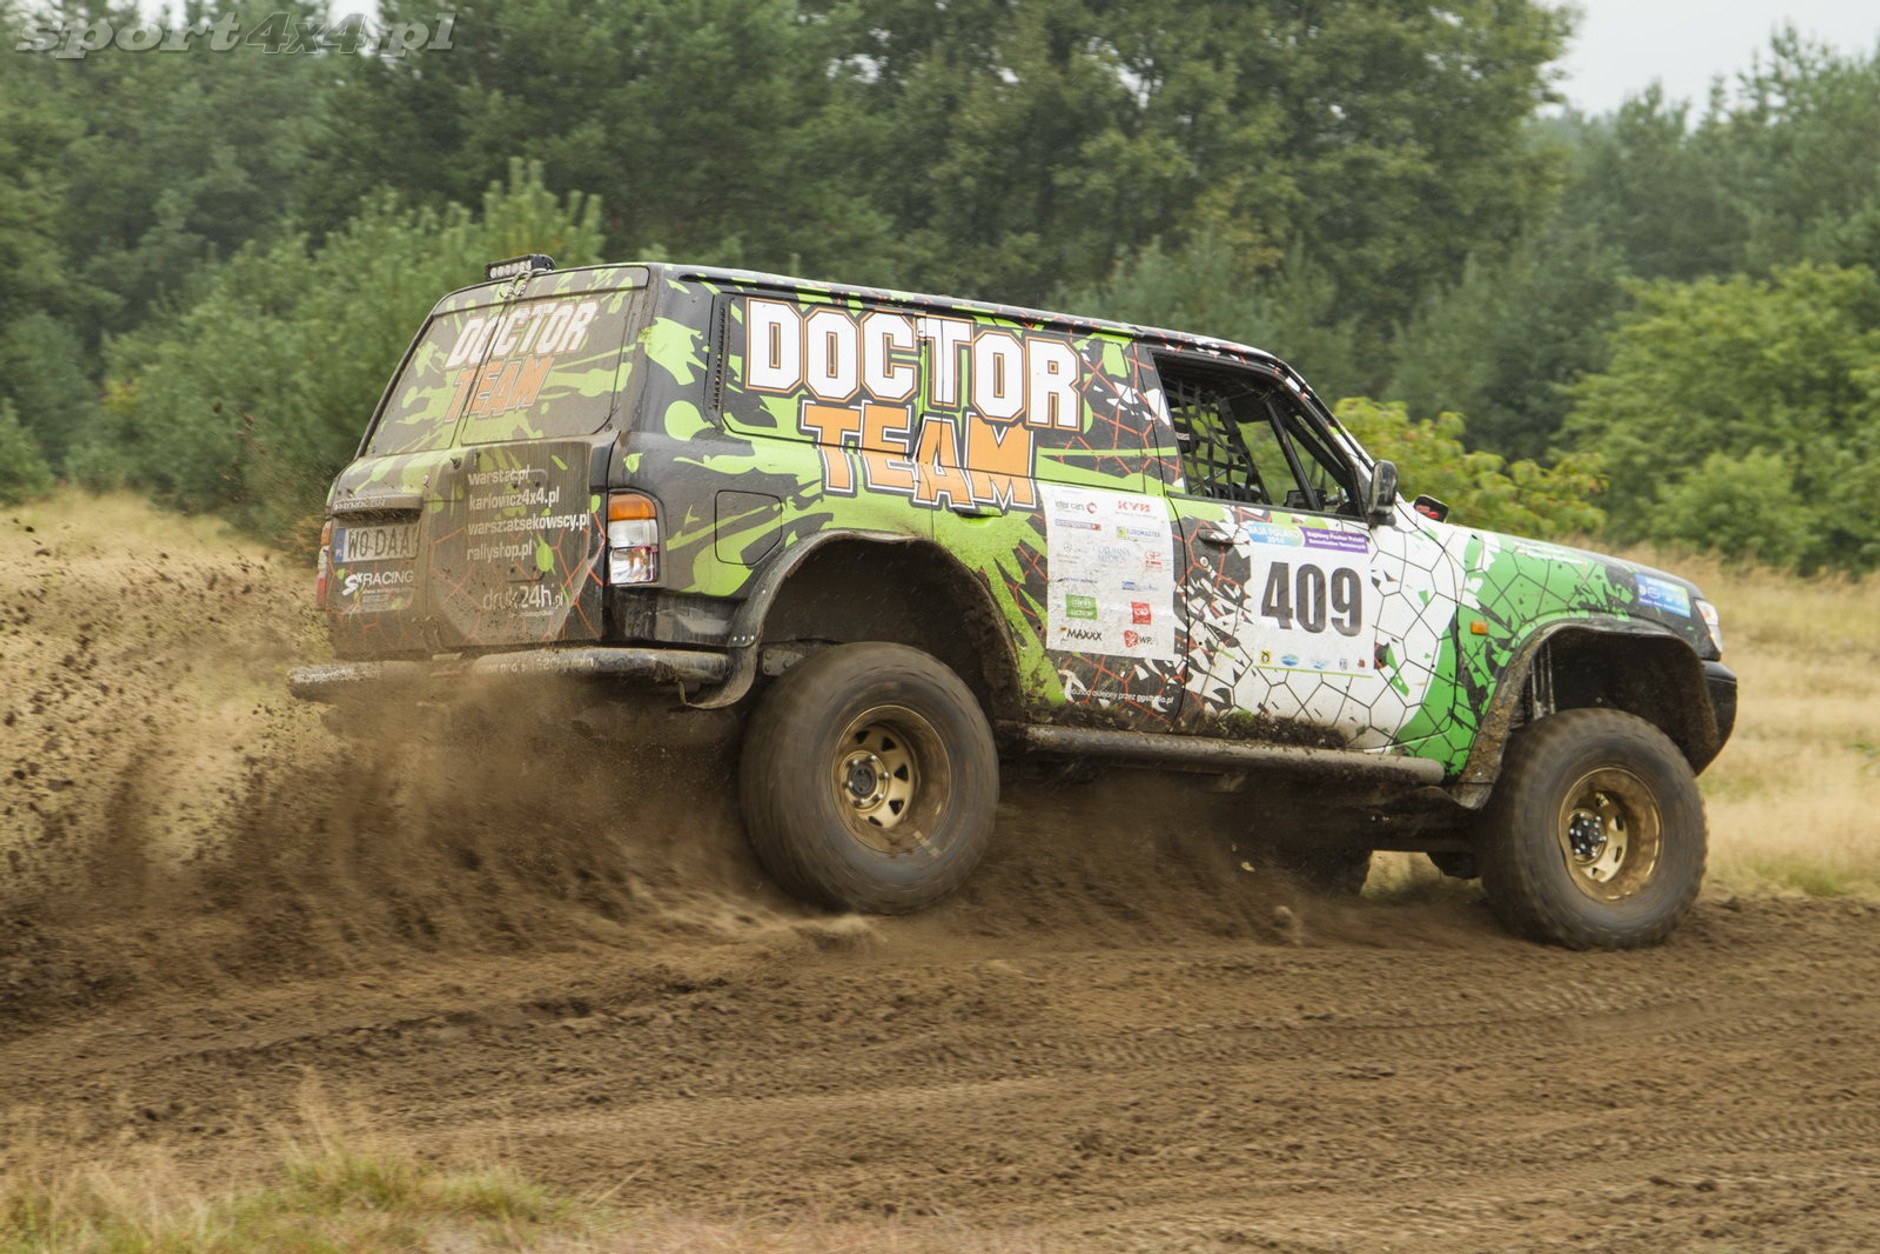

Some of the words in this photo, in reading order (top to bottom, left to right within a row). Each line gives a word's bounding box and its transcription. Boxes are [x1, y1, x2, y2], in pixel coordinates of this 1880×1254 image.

[444, 299, 599, 370] DOCTOR
[745, 297, 1081, 431] DOCTOR
[445, 354, 555, 423] TEAM
[801, 399, 1037, 509] TEAM
[1261, 561, 1362, 638] 409
